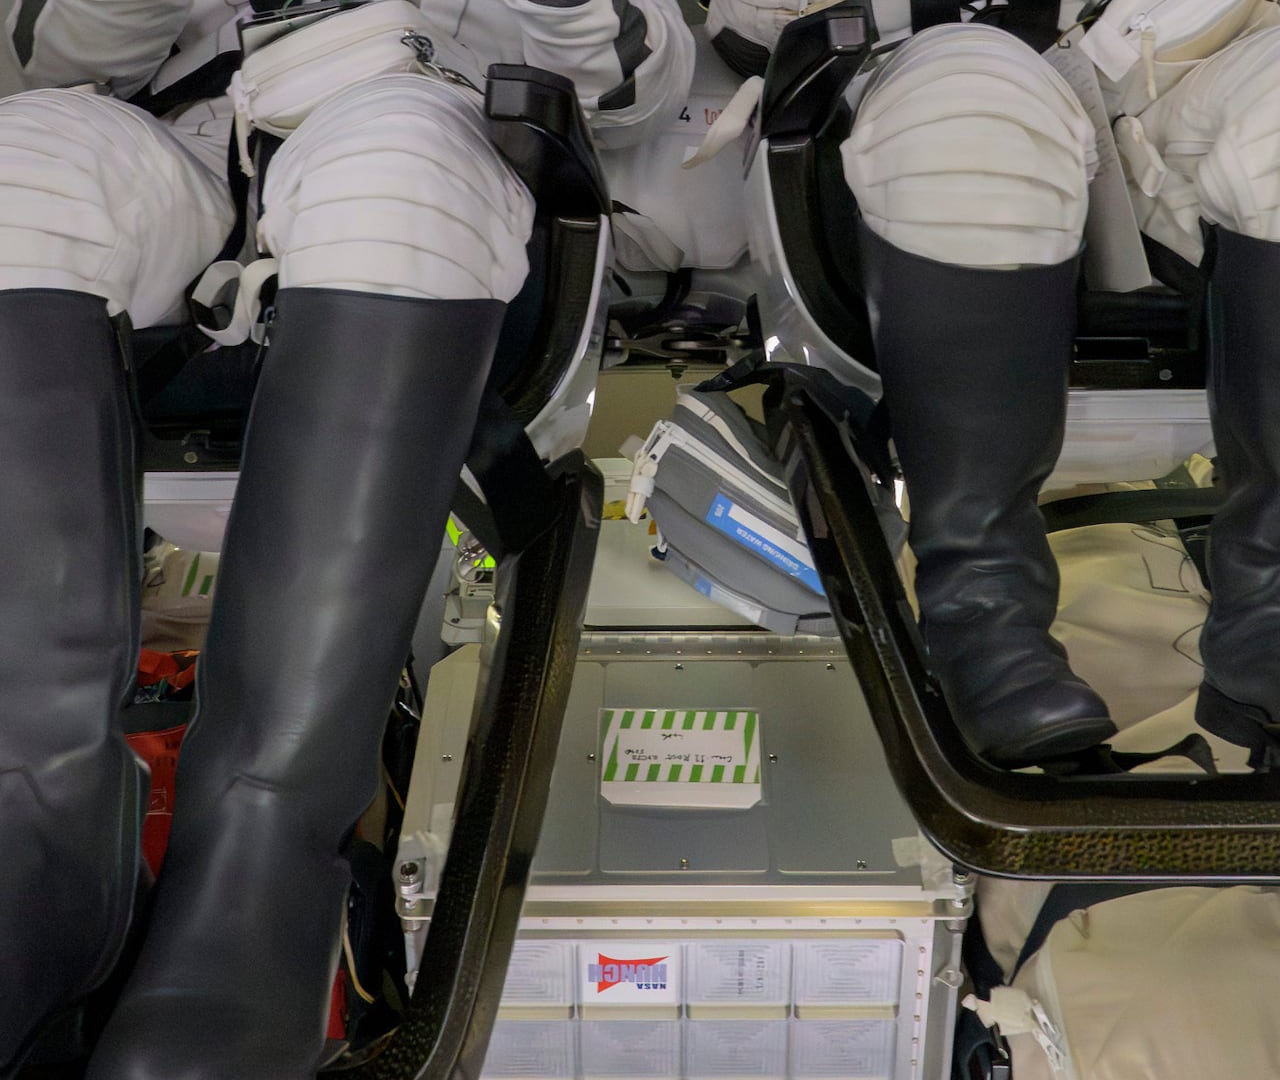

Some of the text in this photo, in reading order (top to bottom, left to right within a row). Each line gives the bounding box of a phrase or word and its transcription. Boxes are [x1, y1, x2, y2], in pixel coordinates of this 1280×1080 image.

[678, 105, 691, 122] 4
[736, 526, 763, 548] WATER
[587, 963, 668, 983] HUNCH
